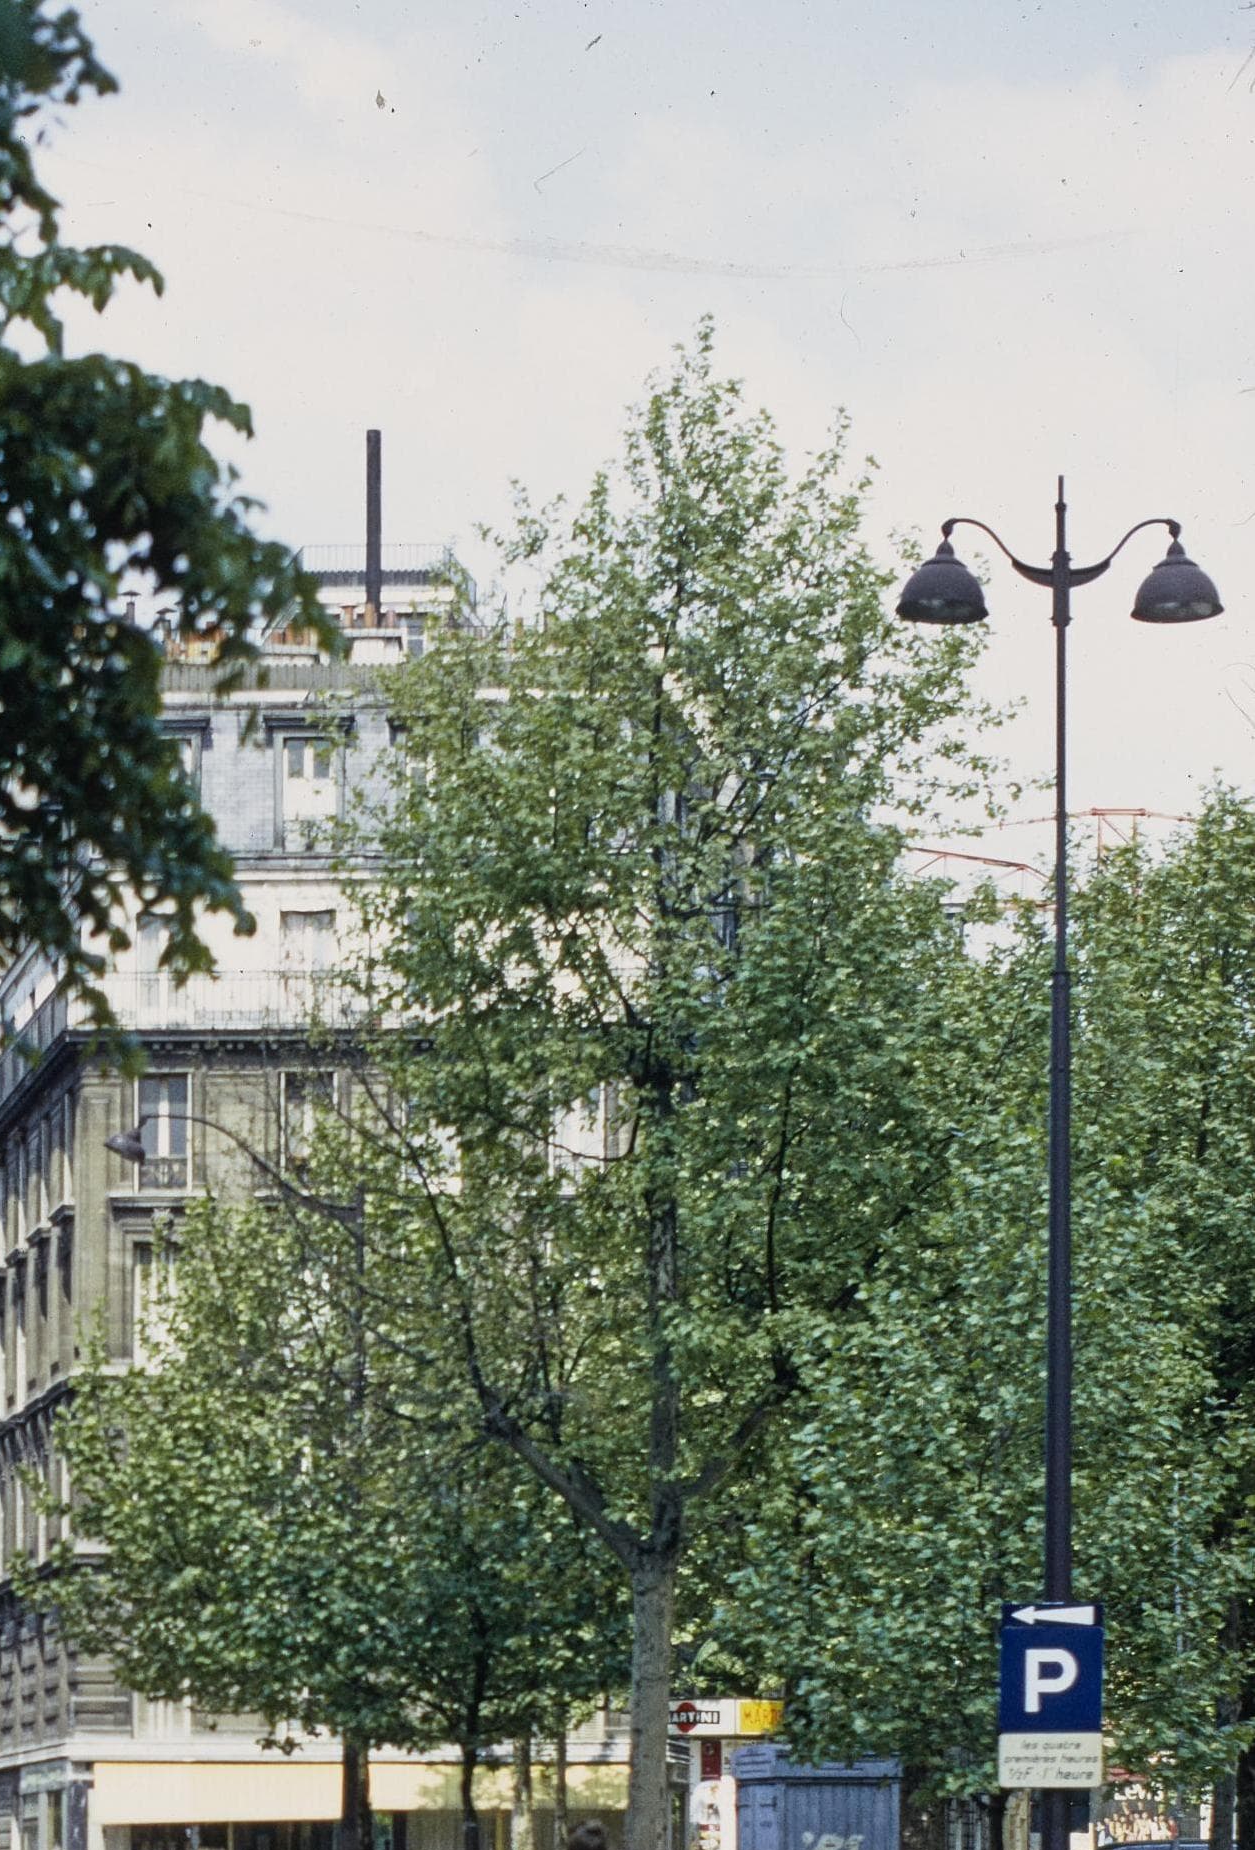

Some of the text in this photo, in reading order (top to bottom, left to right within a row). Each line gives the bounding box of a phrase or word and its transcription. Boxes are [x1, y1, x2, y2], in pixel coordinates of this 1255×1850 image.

[1023, 1647, 1079, 1714] P
[1041, 1741, 1081, 1753] quatre
[1059, 1753, 1099, 1764] heures
